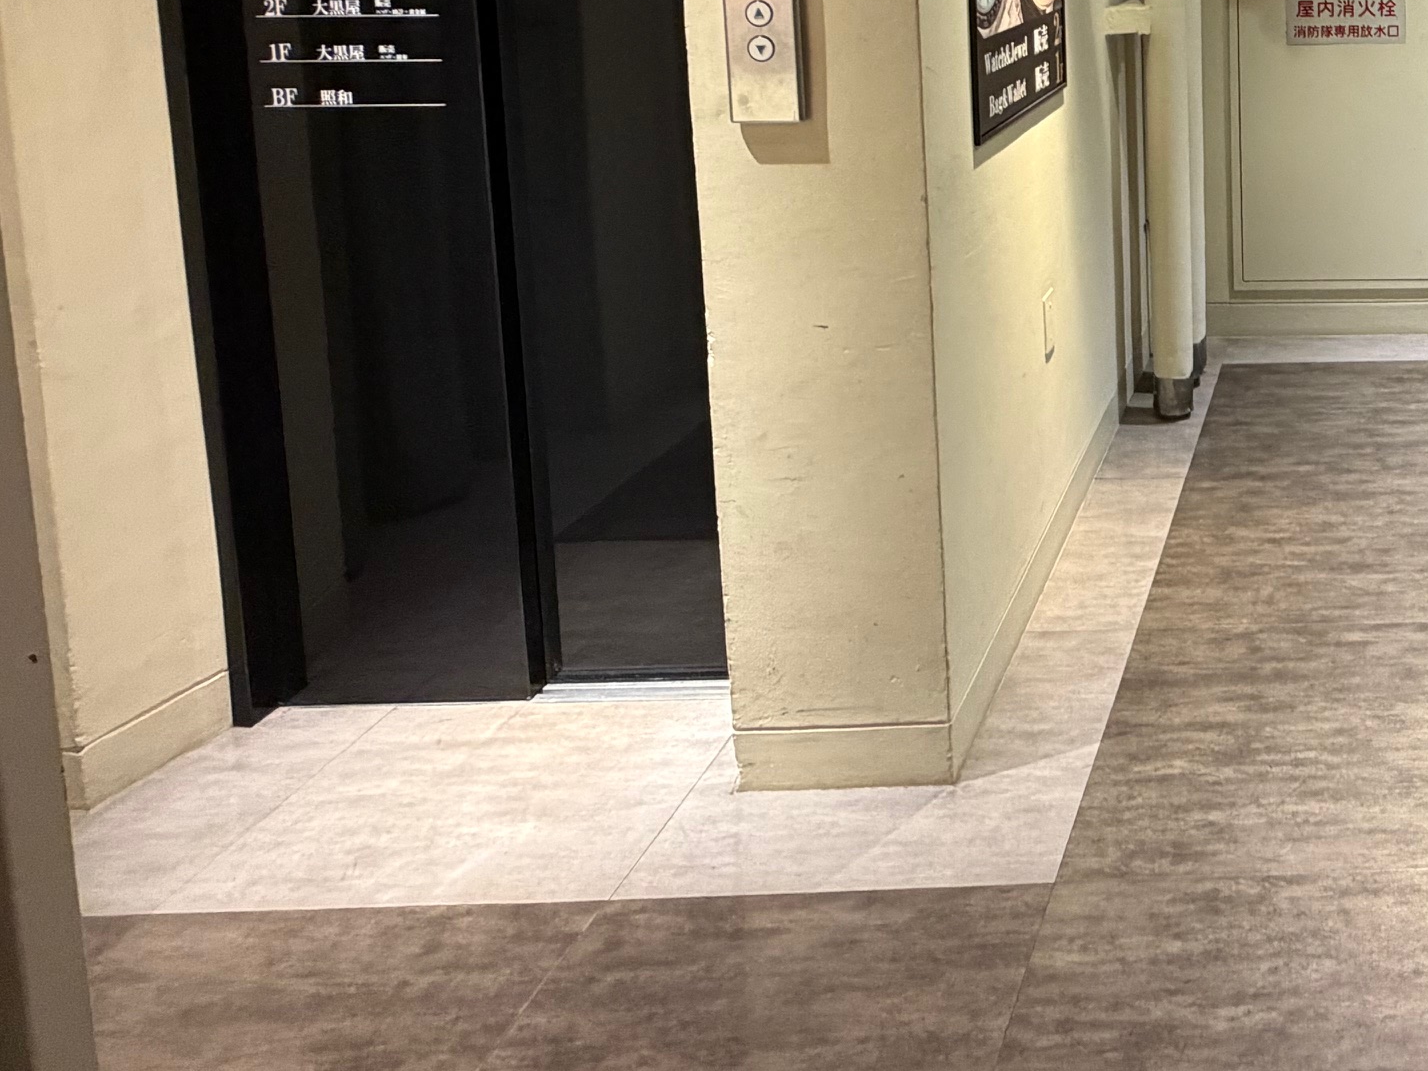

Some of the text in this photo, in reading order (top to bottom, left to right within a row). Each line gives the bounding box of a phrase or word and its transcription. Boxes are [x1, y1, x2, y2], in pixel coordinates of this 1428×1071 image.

[312, 0, 362, 15] 大黒屋
[1296, 0, 1397, 18] 屋内消火栓
[268, 43, 292, 61] 1F
[316, 44, 366, 60] 大黒屋
[271, 88, 354, 106] BF 照和
